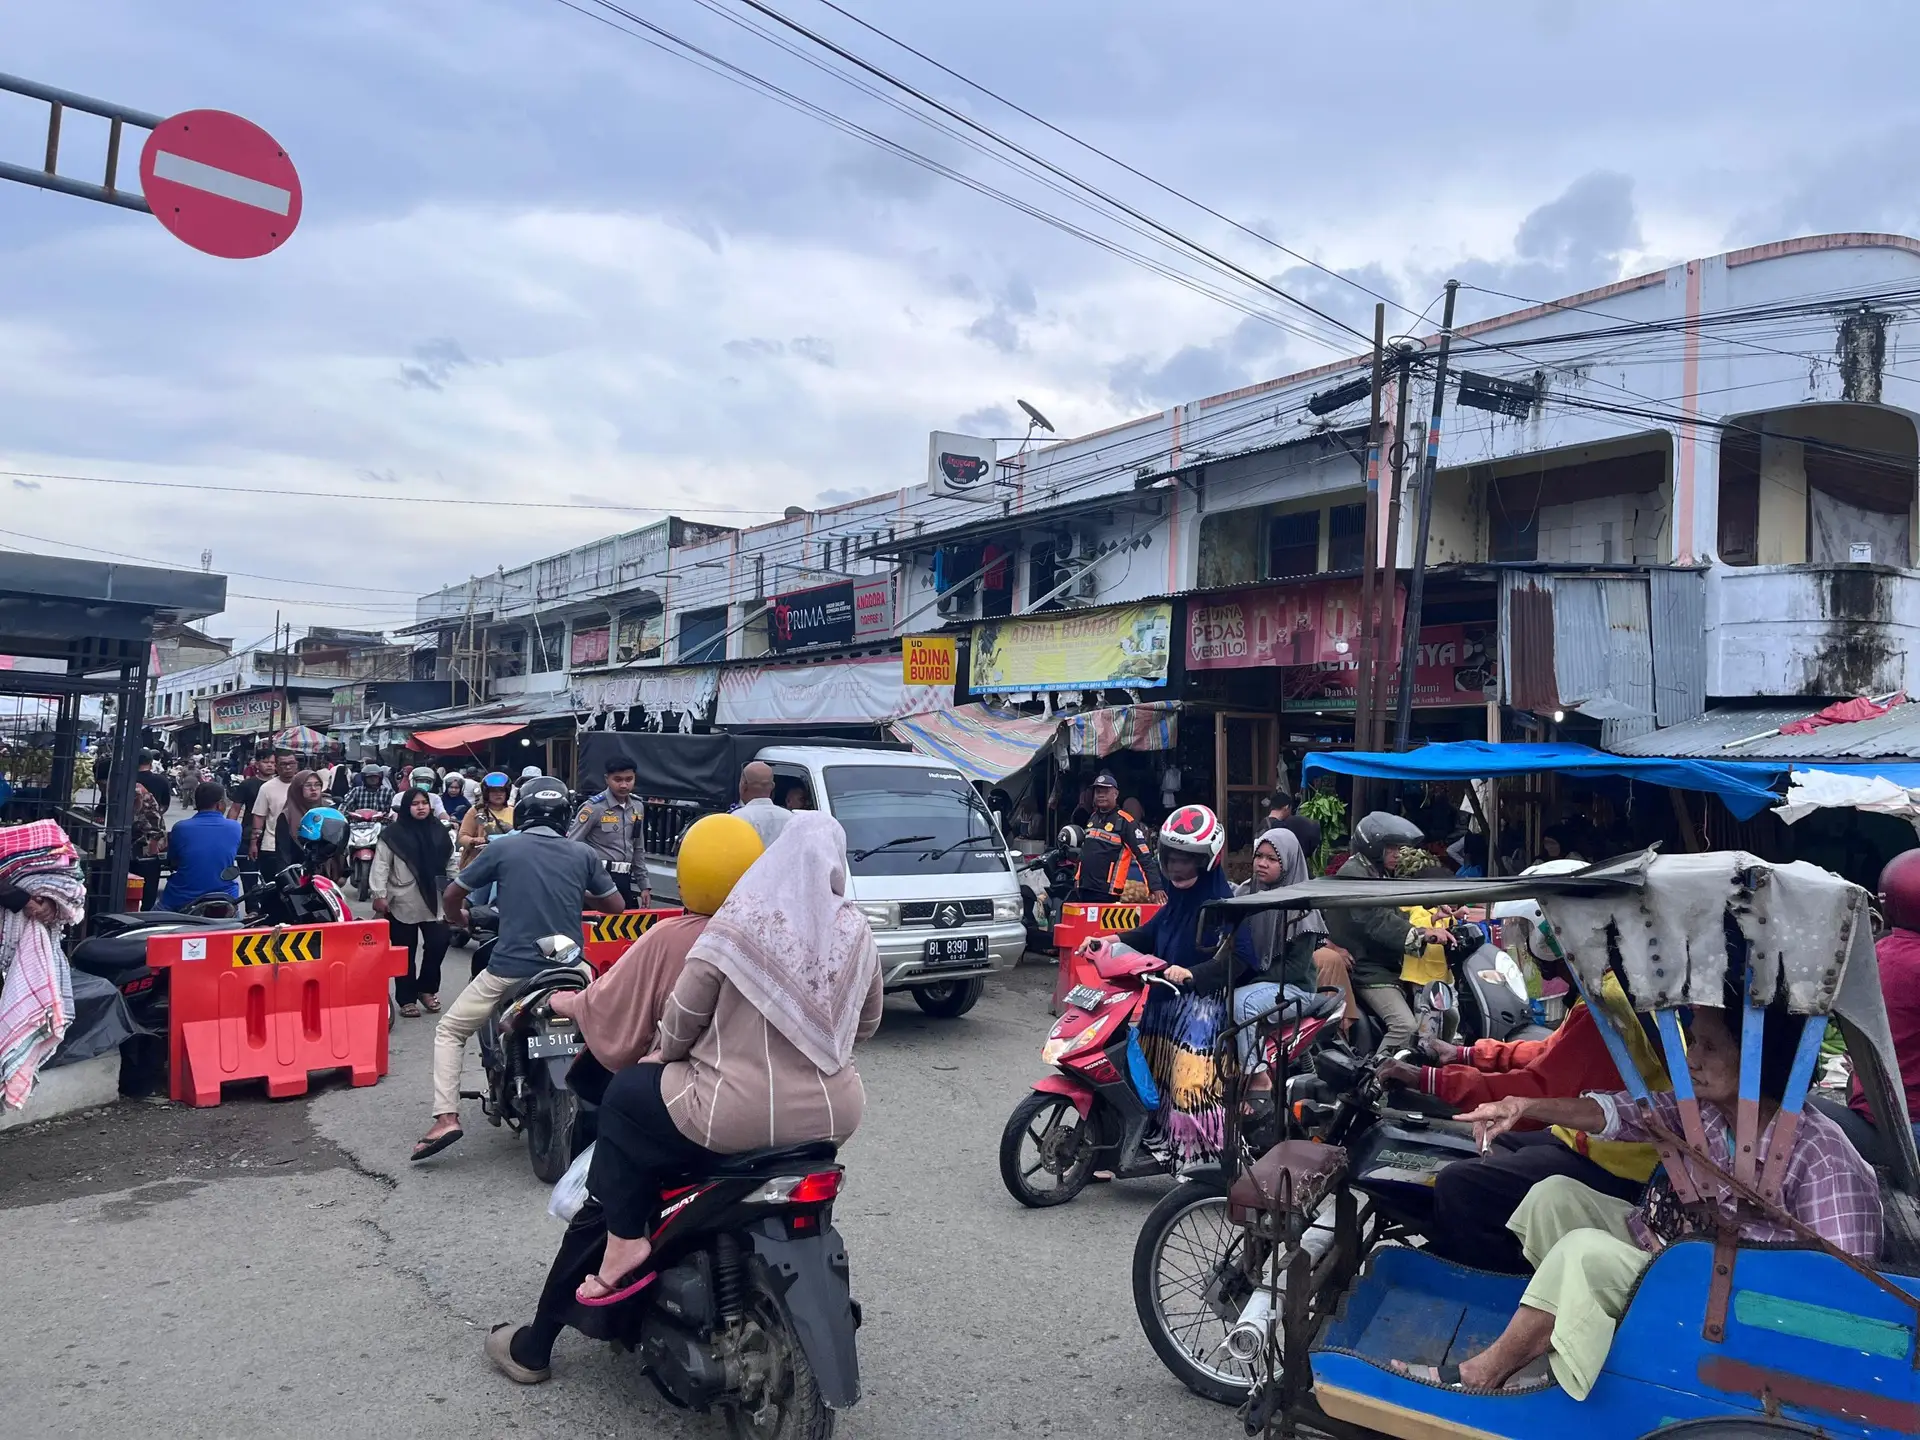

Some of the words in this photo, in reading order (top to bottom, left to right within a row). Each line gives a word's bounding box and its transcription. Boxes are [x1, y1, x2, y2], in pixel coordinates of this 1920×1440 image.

[786, 605, 826, 631] PRIMA
[1009, 623, 1056, 643] ADINA
[1192, 620, 1244, 644] PEDAS
[911, 640, 923, 648] UD
[1192, 644, 1224, 660] VERSI
[1227, 641, 1247, 656] LO!
[910, 648, 950, 665] ADINA
[910, 666, 950, 681] BUMBU
[1324, 687, 1342, 698] Dan
[1413, 682, 1440, 694] Bumi
[216, 705, 244, 717] MIE
[929, 941, 941, 956] BL
[946, 939, 968, 954] 8390
[974, 938, 984, 952] JA
[527, 1036, 542, 1049] BL
[1376, 1149, 1439, 1169] WIN
